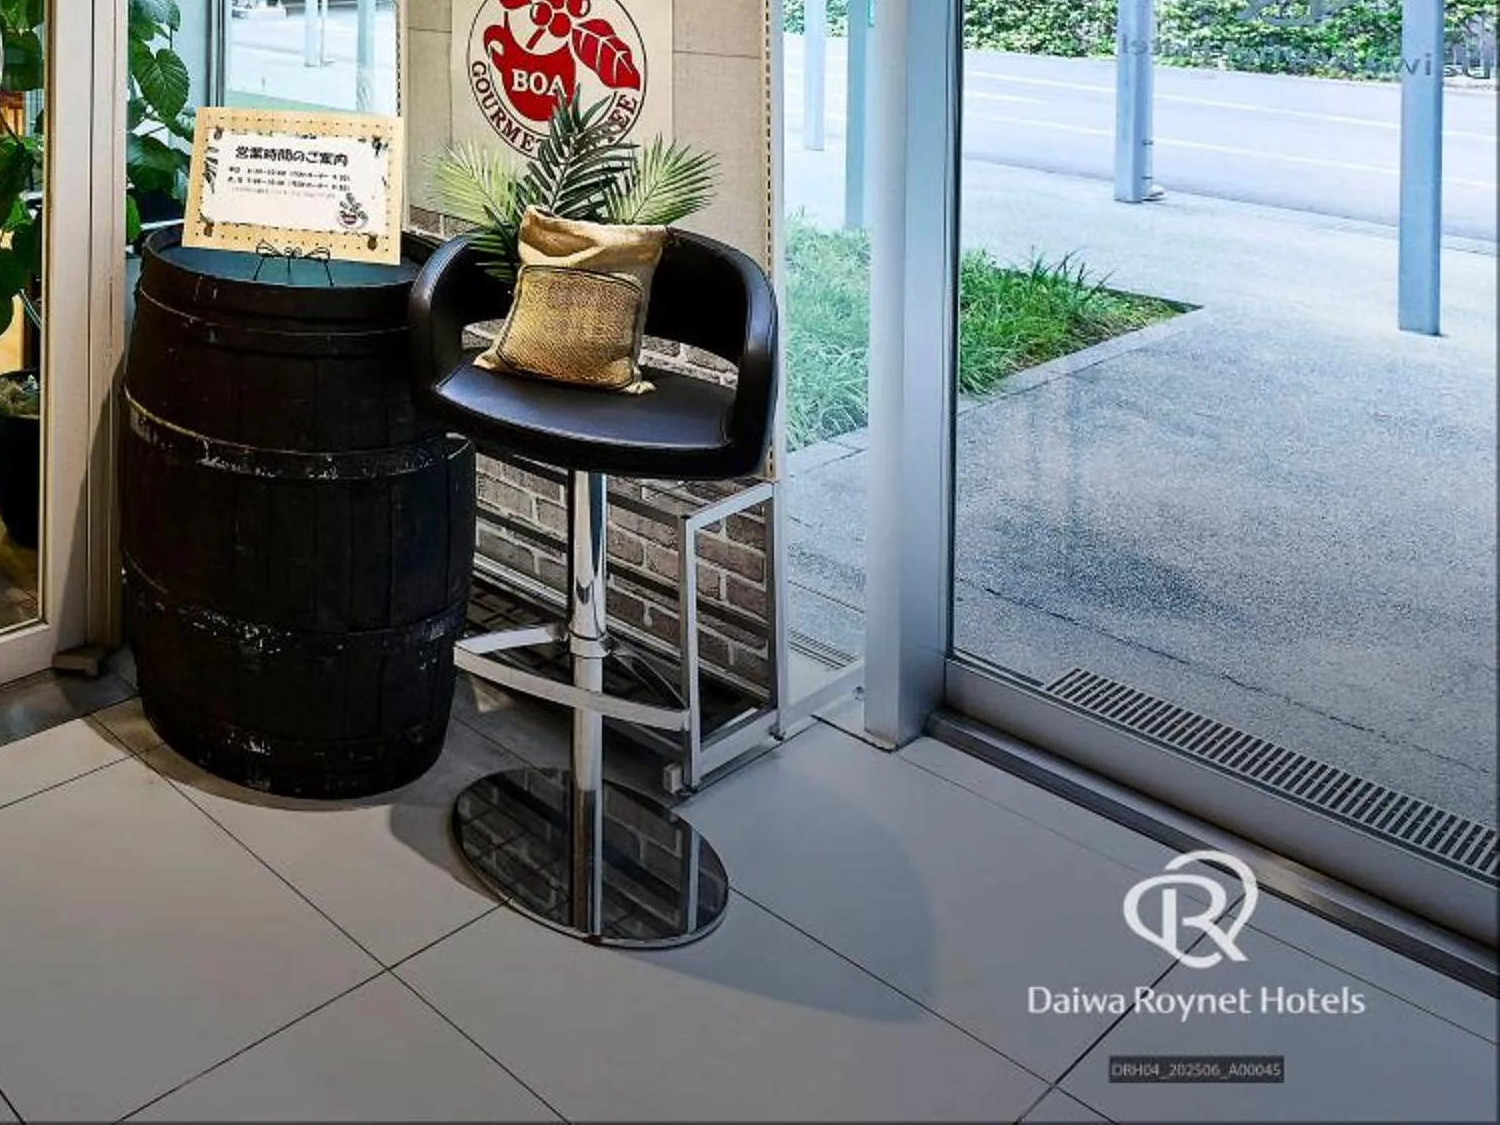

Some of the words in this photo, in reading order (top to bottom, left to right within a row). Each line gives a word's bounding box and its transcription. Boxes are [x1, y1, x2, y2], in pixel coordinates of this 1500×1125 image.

[512, 68, 569, 97] BOA
[472, 61, 543, 153] GOURME
[235, 145, 349, 168] 営業時間のご案内
